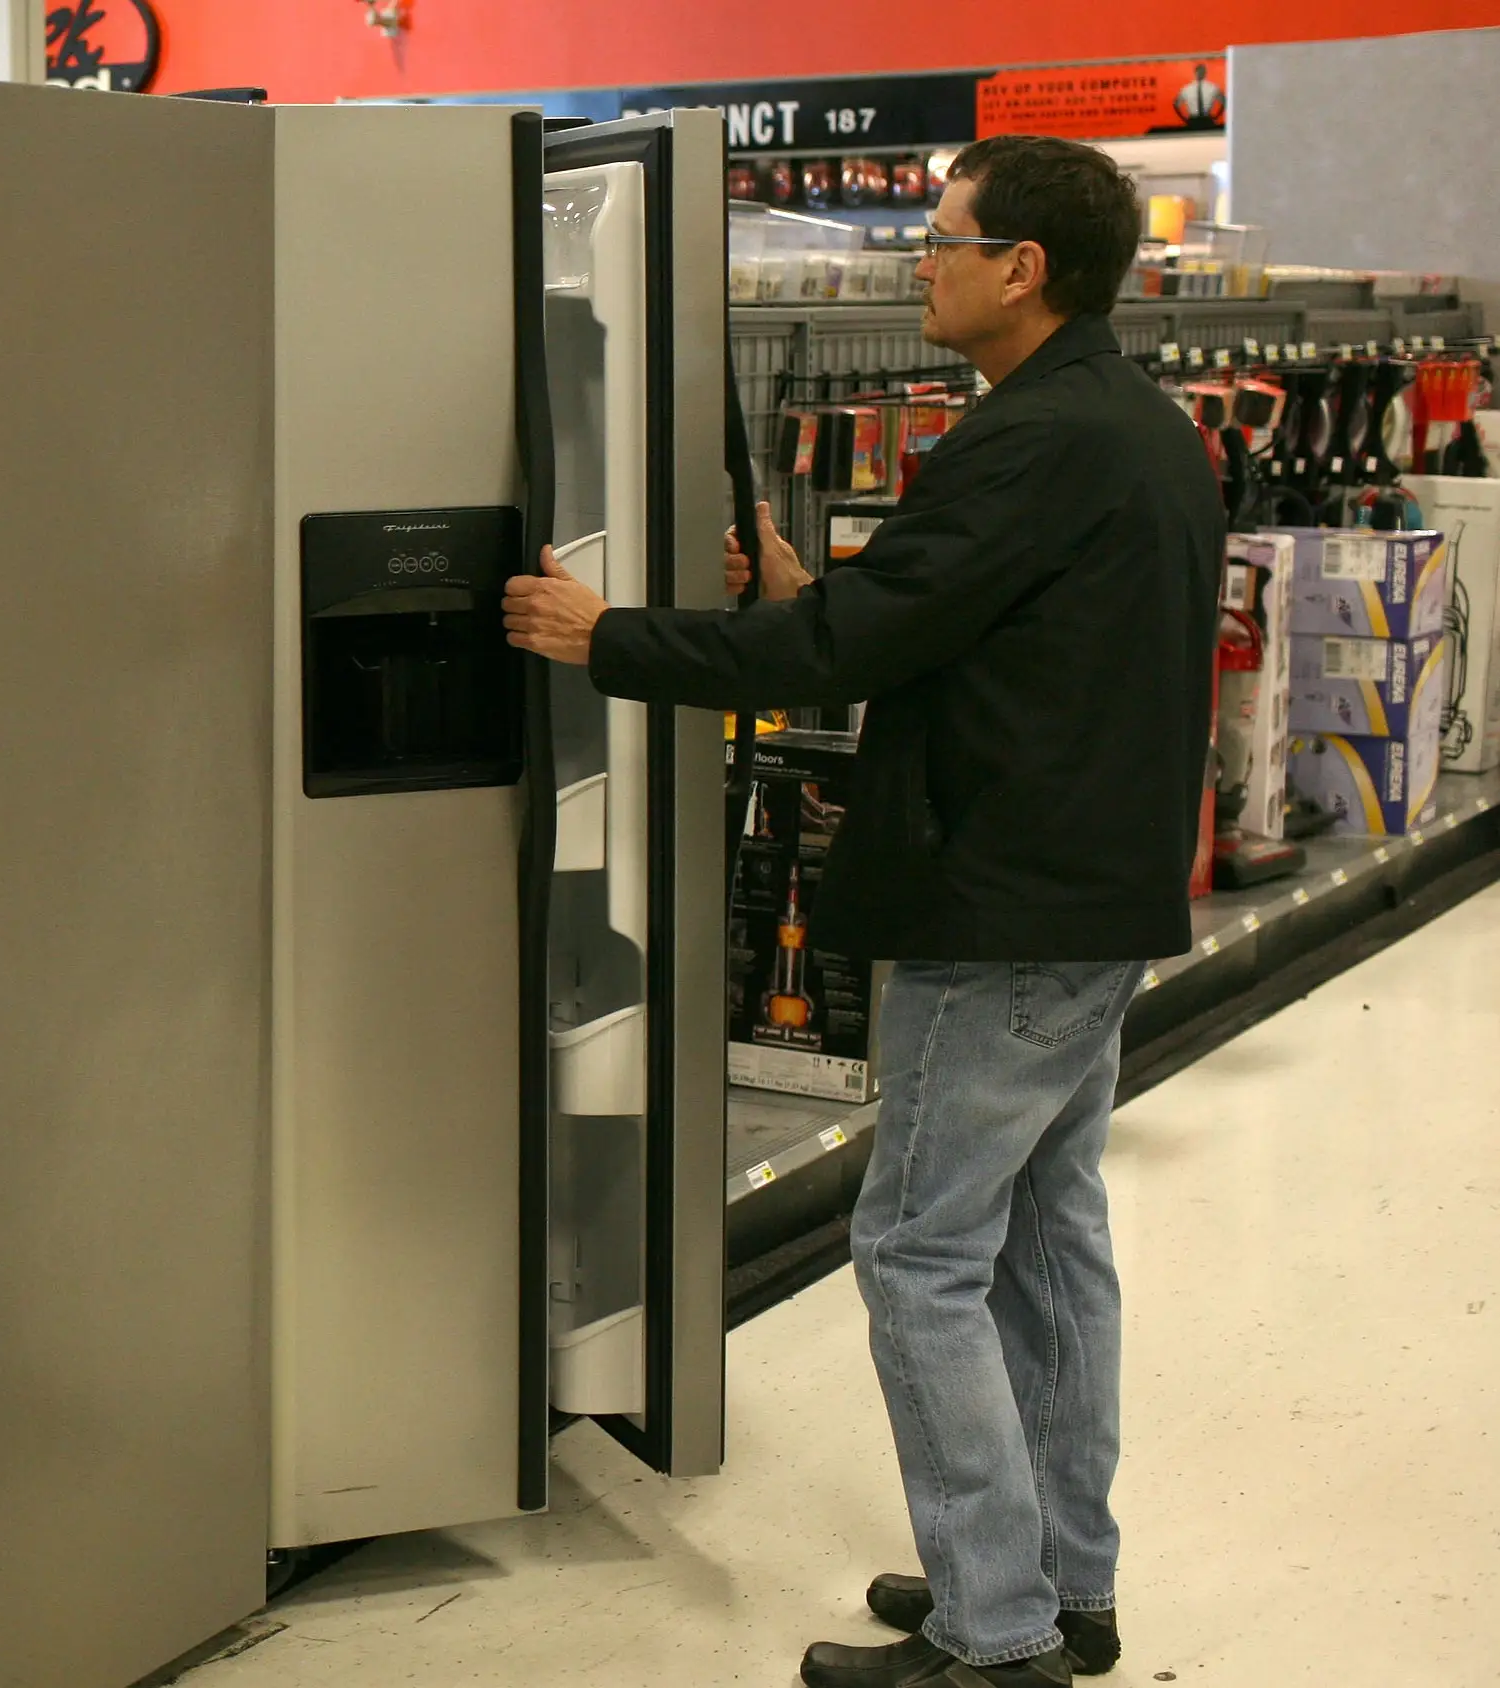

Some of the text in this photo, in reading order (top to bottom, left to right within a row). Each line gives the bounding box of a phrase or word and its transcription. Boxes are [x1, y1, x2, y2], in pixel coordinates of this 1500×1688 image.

[983, 76, 1157, 96] REV UP YOUR COMPUTER
[825, 107, 877, 134] 187
[383, 522, 451, 533] Frigidaire
[1392, 541, 1408, 604] EUREKA
[1391, 643, 1408, 704] EUREKA
[1389, 741, 1405, 802] EUREKA
